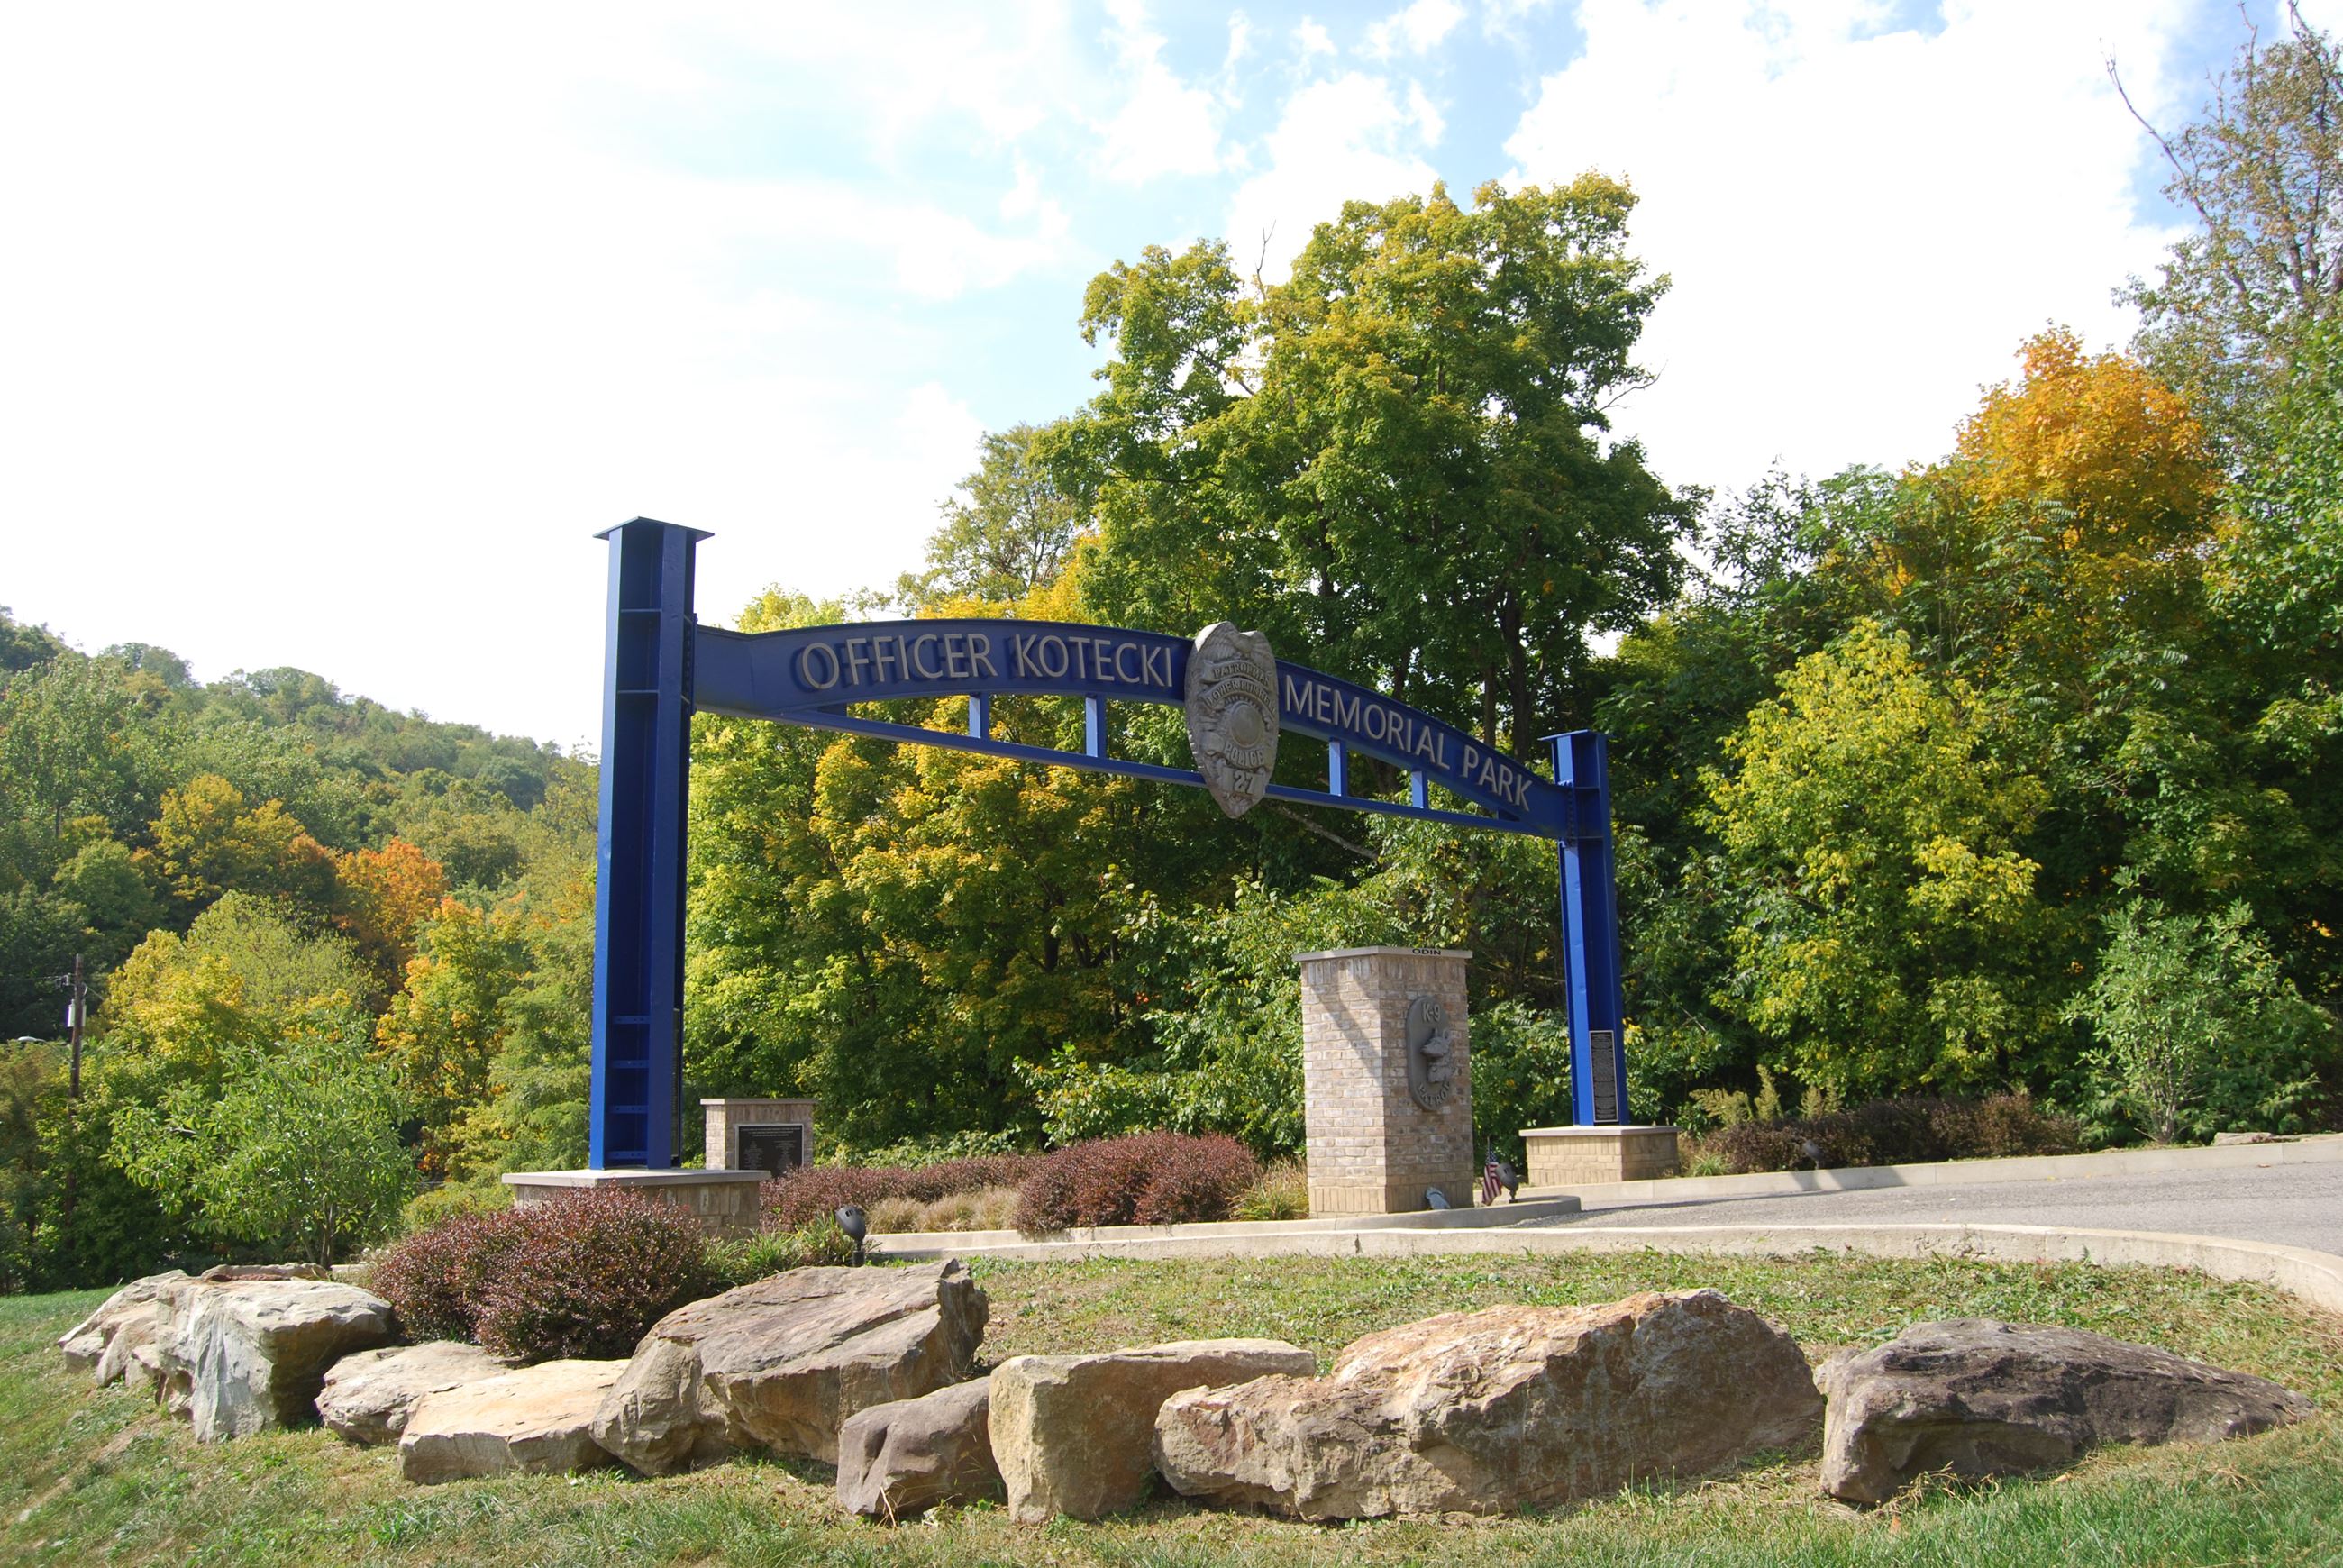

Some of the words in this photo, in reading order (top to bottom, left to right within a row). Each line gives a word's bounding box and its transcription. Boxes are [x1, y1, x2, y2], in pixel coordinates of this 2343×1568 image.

[1213, 662, 1270, 686] PATROLMAN
[1206, 680, 1239, 707] LOWER
[801, 633, 998, 690] OFFICER
[1015, 634, 1173, 688] KOTECKI
[1285, 674, 1451, 770] MEMORIAL
[1462, 744, 1534, 812] PARK
[1224, 742, 1265, 767] POLICE
[1233, 770, 1254, 795] 27
[1412, 948, 1442, 956] ODIN
[1422, 1002, 1441, 1023] K-9
[1418, 1081, 1451, 1106] PATROL
